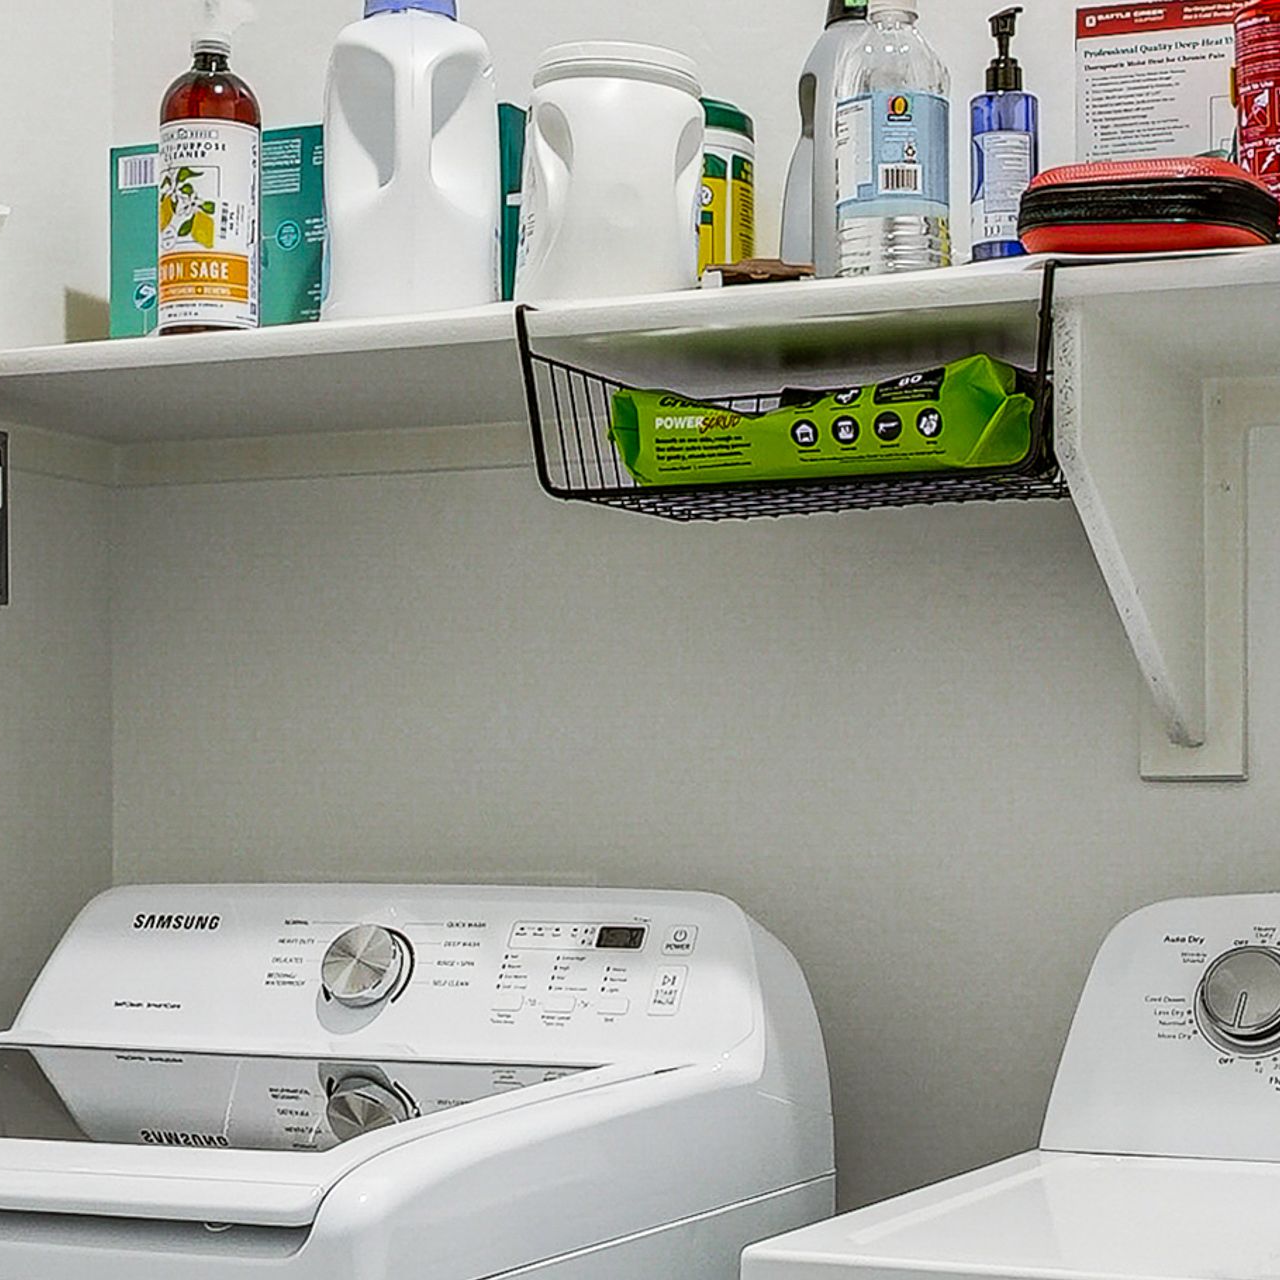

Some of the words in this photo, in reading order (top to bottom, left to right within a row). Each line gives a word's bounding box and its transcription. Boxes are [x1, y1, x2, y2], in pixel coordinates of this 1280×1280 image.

[1084, 48, 1138, 58] Professional
[1139, 44, 1172, 54] Quality
[190, 260, 229, 280] SAGE
[133, 914, 221, 930] SAMSUNG
[1163, 935, 1186, 943] Auto
[1188, 935, 1205, 944] Dry
[665, 943, 690, 951] POWER
